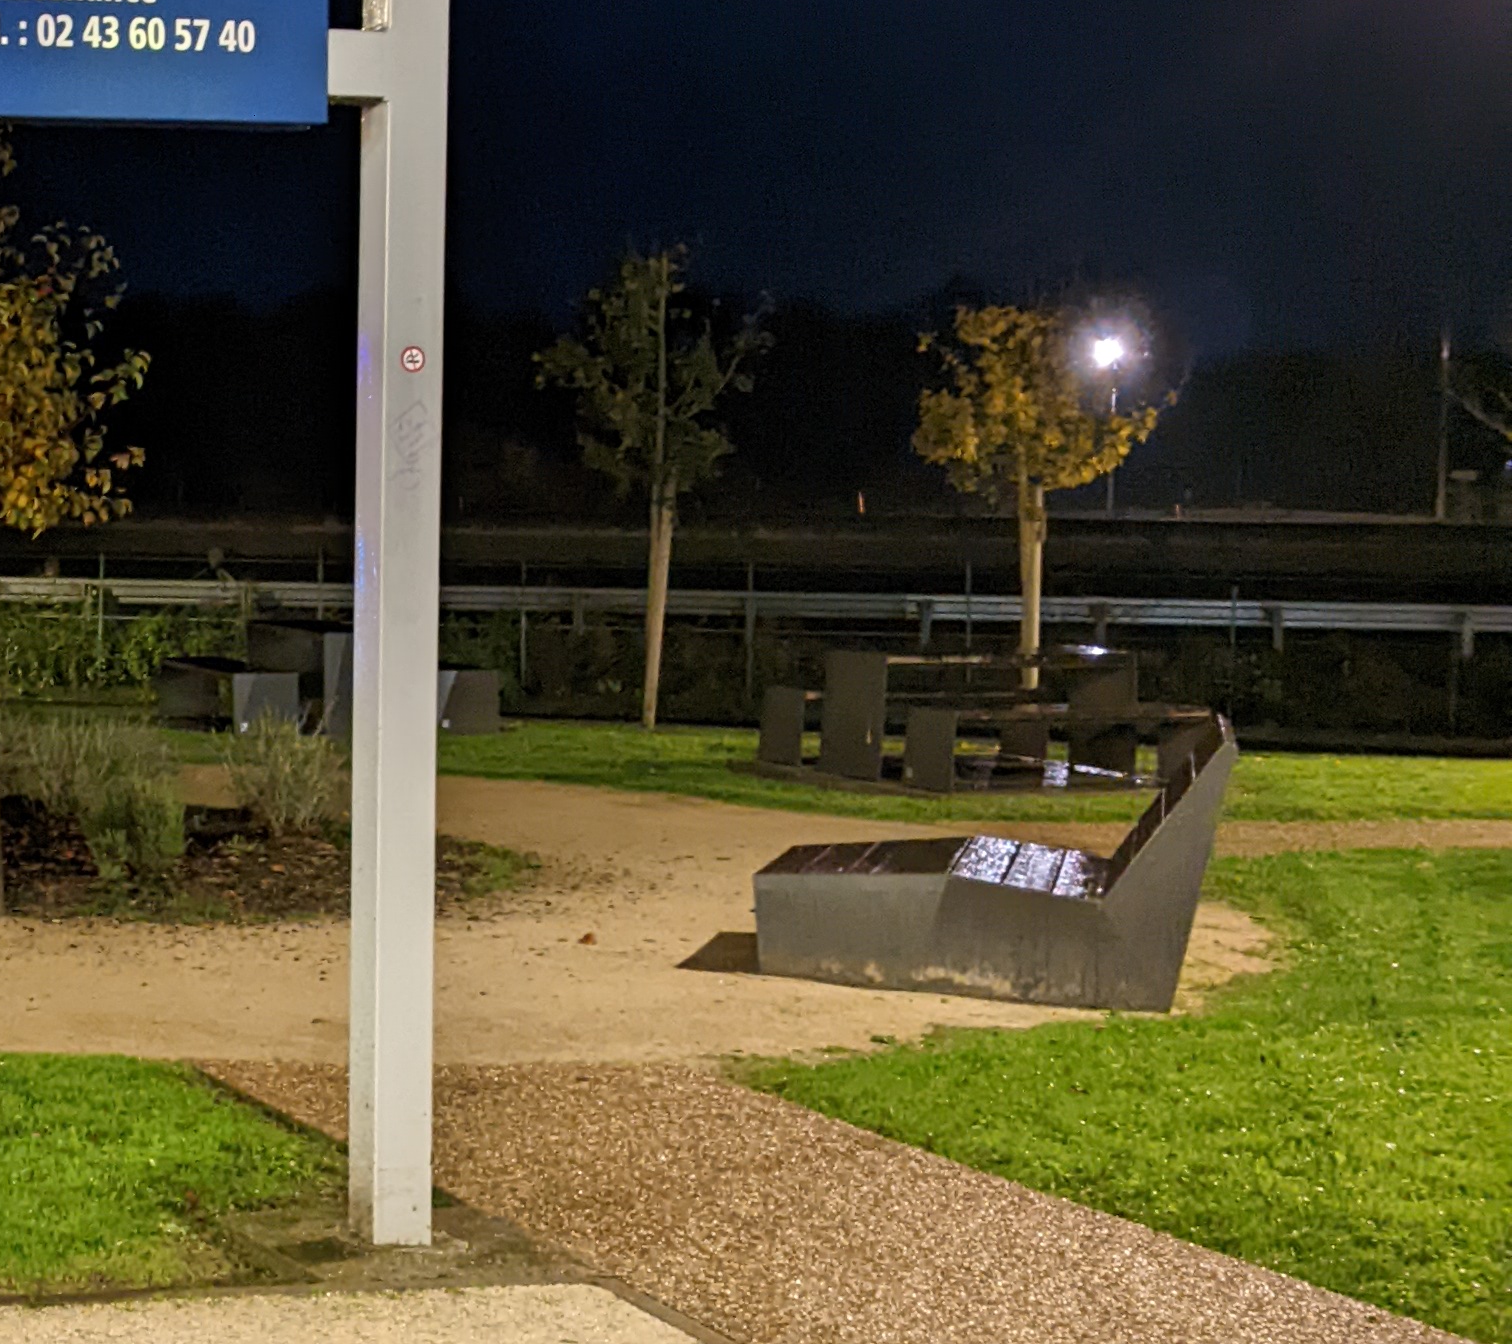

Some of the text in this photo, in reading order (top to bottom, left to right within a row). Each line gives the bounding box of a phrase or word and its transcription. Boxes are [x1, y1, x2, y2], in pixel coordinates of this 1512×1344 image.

[36, 14, 74, 48] 02
[83, 15, 120, 50] 43
[128, 16, 166, 51] 60
[174, 18, 210, 52] 57
[219, 19, 256, 53] 40
